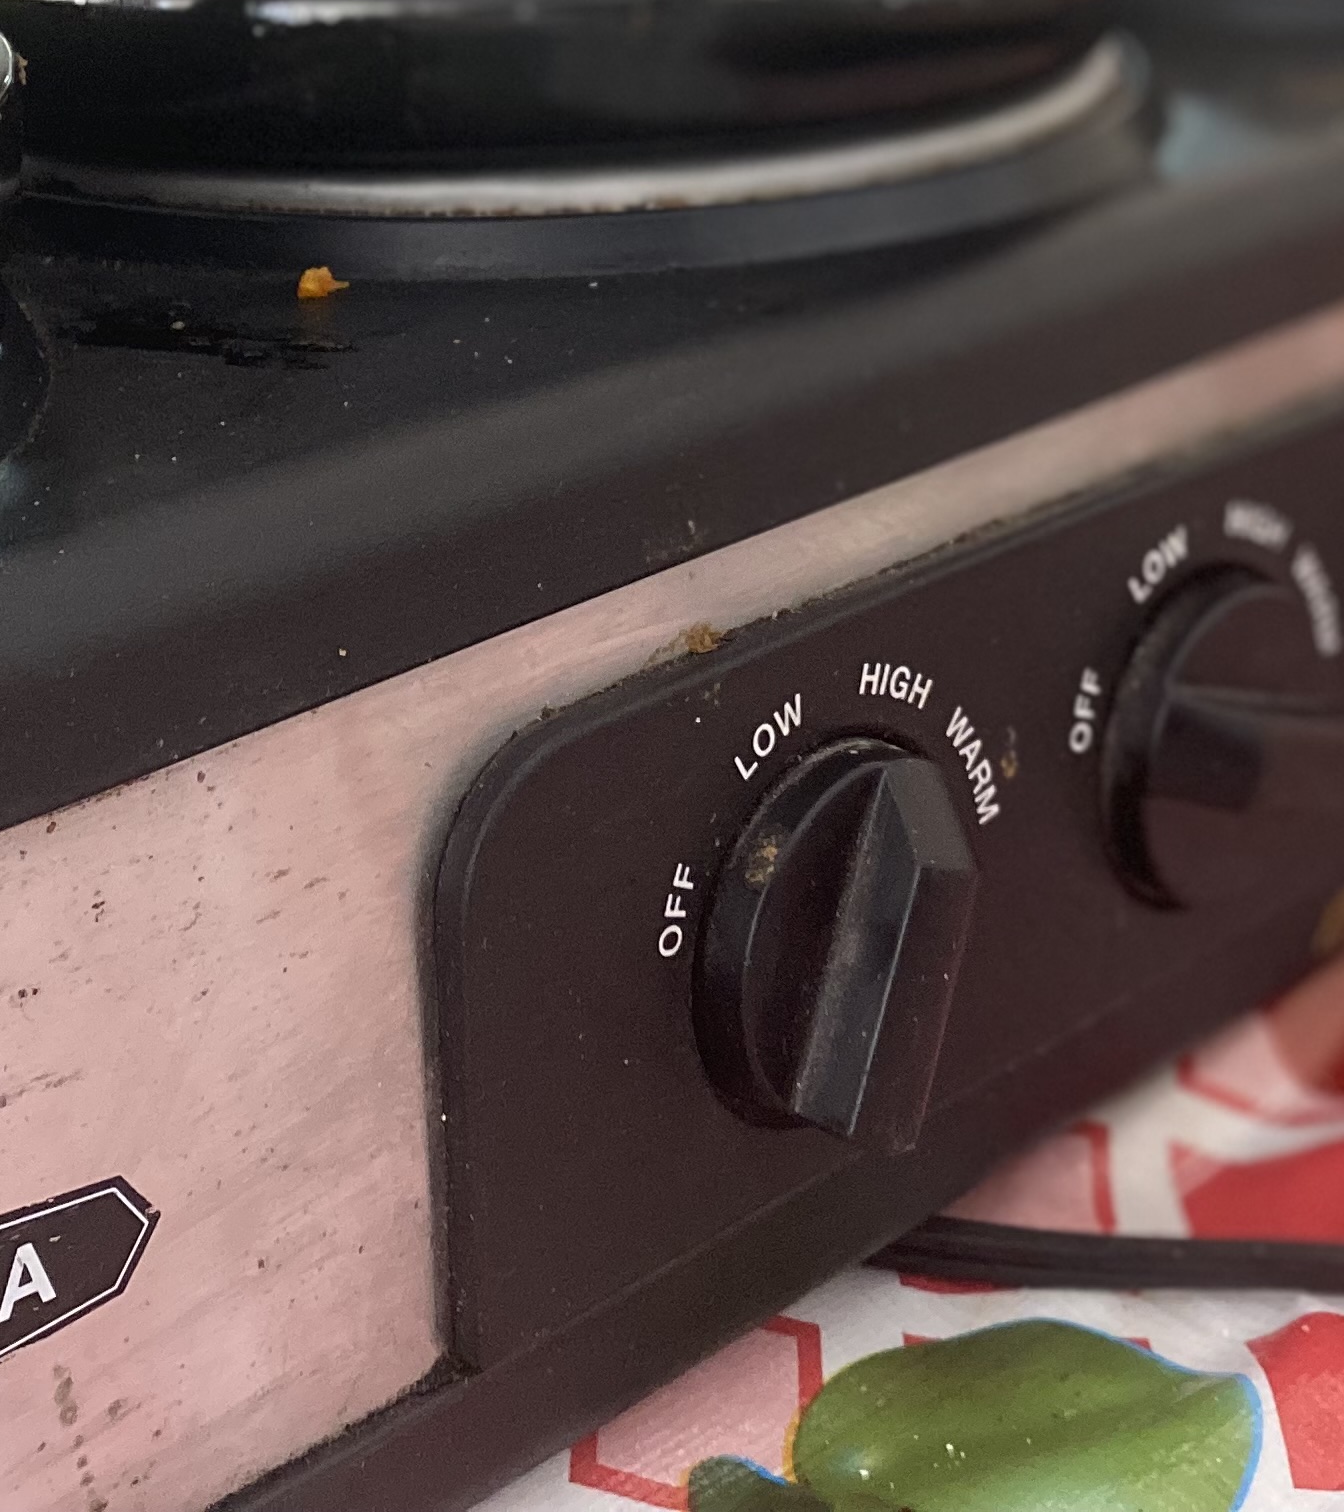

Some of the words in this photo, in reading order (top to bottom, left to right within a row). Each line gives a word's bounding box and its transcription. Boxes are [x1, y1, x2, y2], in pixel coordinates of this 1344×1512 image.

[1128, 524, 1188, 603] LOW
[858, 662, 933, 710] HIGH
[1069, 667, 1101, 753] OFF
[734, 692, 802, 781] LOW
[945, 705, 1000, 825] WARM
[659, 863, 694, 958] OFF
